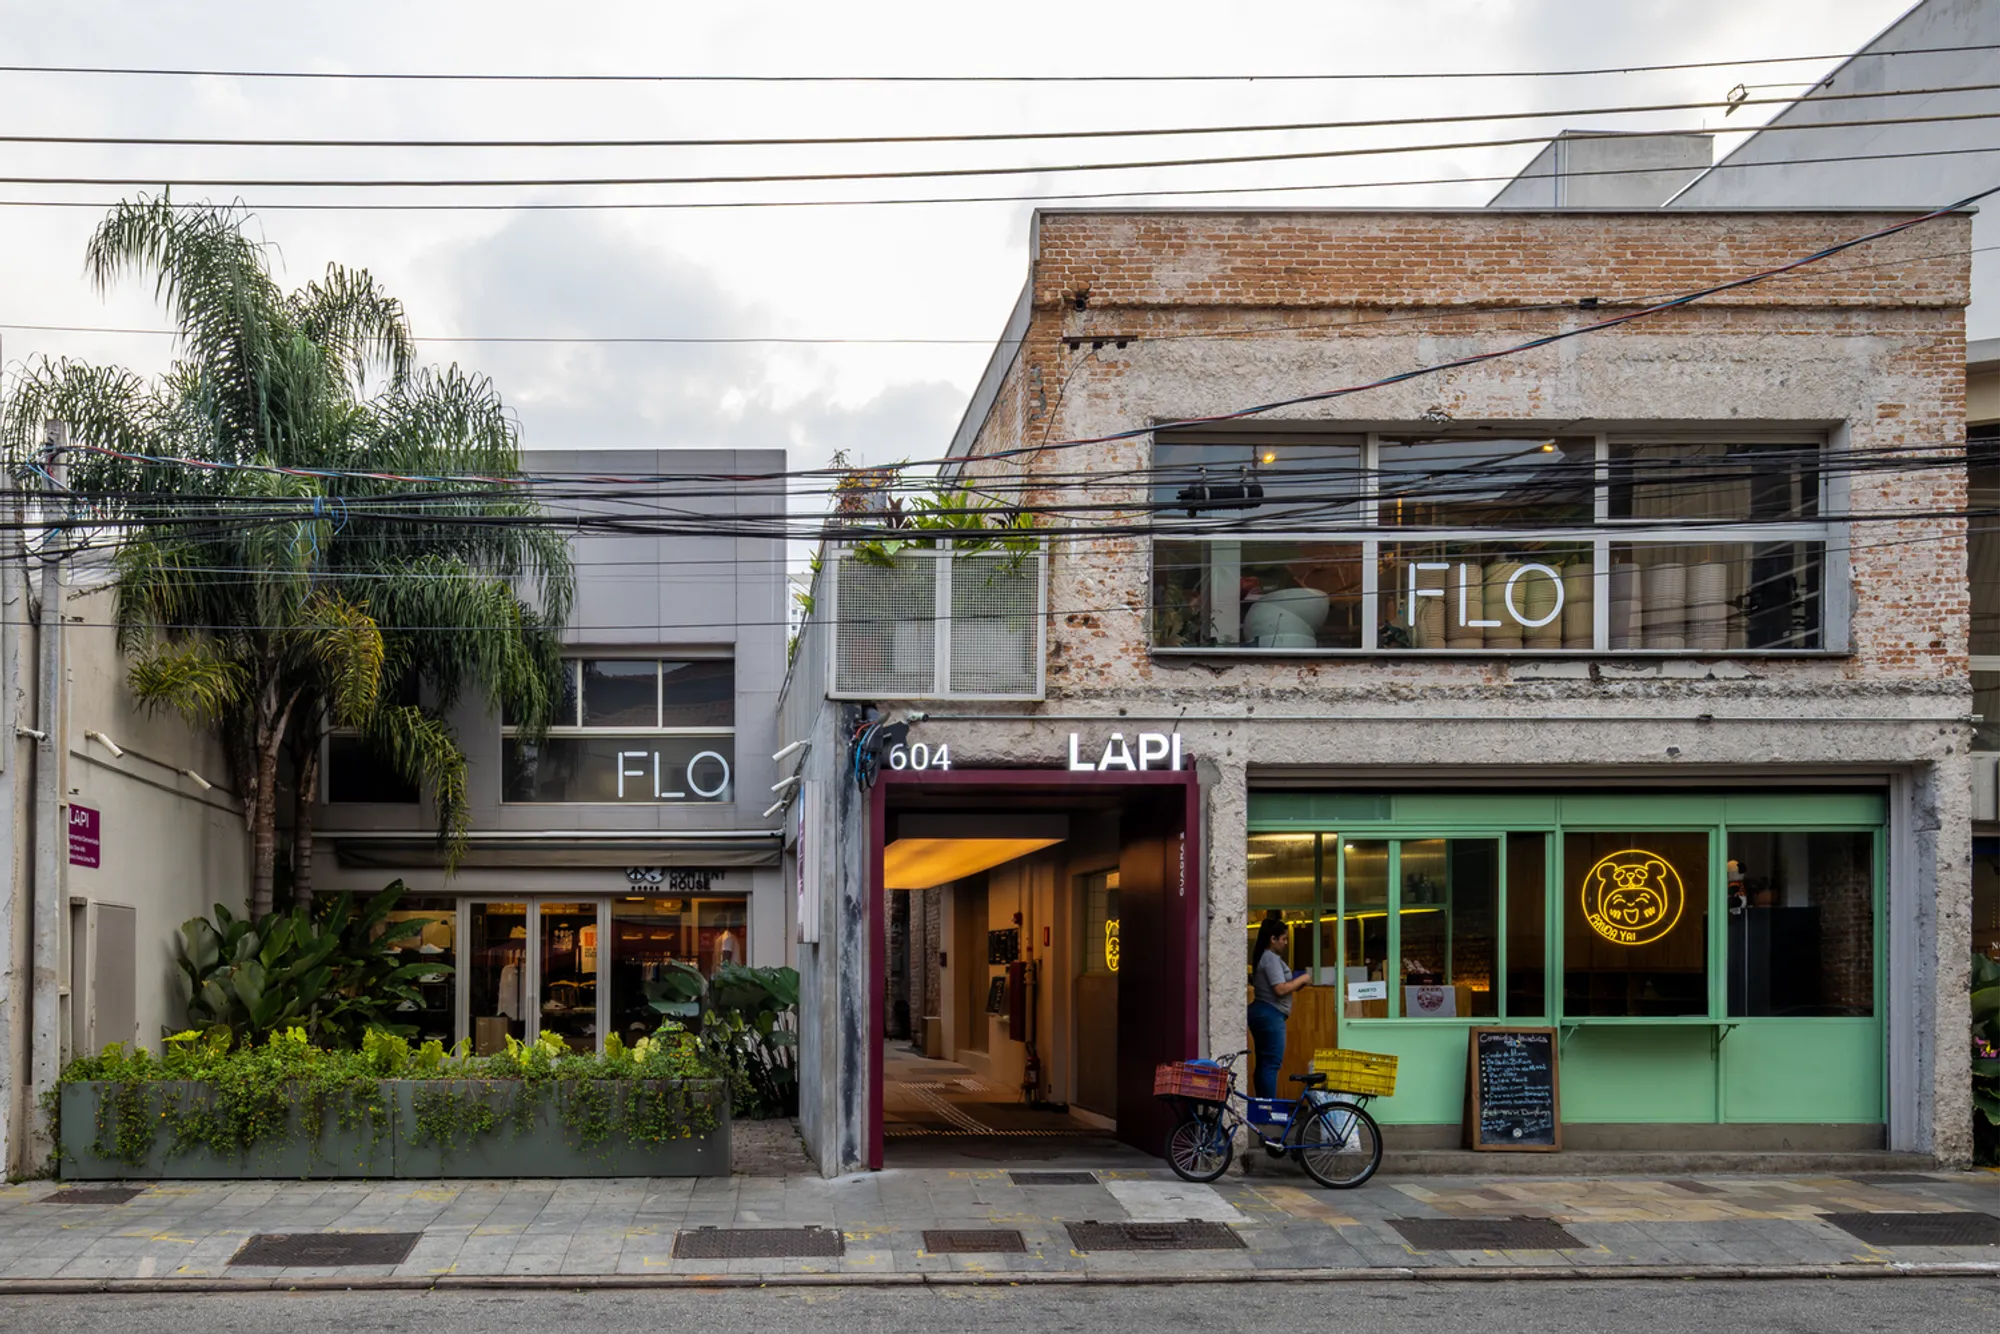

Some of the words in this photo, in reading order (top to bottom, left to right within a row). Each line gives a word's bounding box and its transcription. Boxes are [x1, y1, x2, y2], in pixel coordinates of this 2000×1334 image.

[1408, 562, 1565, 628] FLO
[889, 742, 952, 771] 604
[1068, 732, 1182, 771] LAPI
[617, 750, 730, 798] FLO
[69, 807, 90, 829] LAPI
[669, 867, 727, 881] CONTENT
[669, 879, 712, 891] HOUSE
[1589, 913, 1619, 941] PANDA
[1619, 930, 1637, 942] YAI
